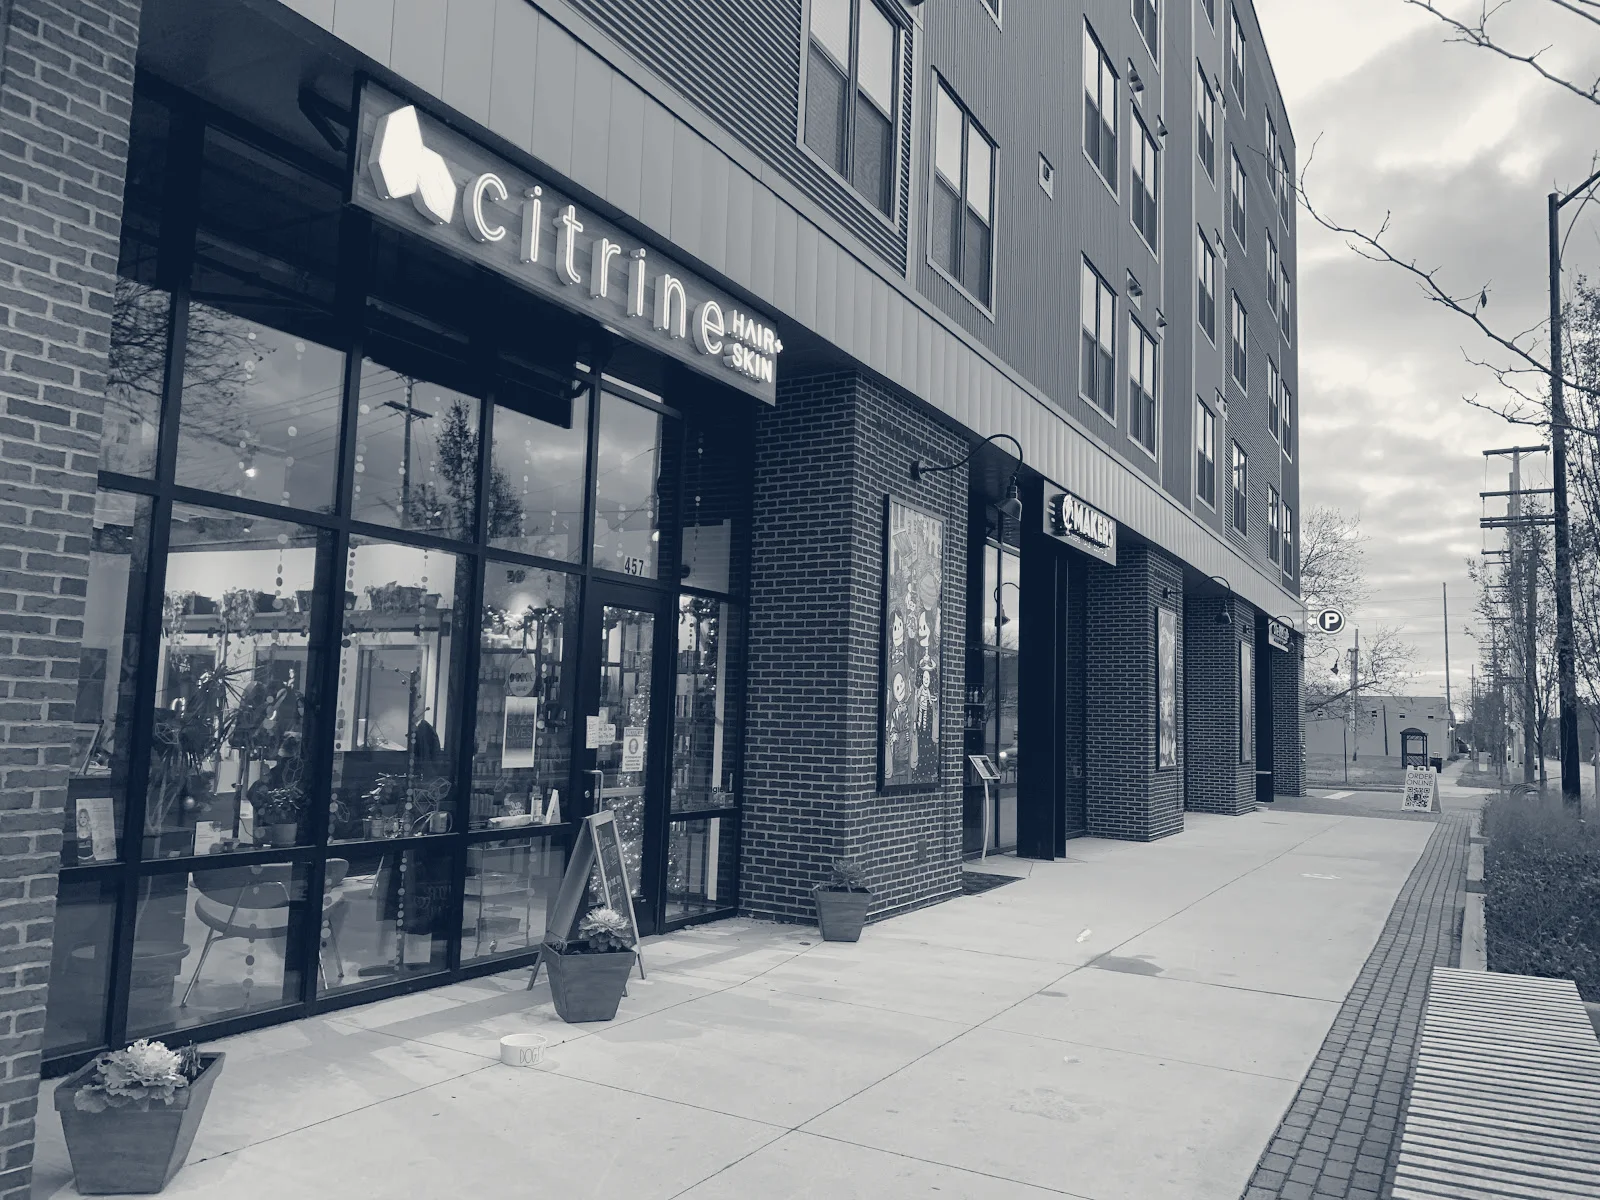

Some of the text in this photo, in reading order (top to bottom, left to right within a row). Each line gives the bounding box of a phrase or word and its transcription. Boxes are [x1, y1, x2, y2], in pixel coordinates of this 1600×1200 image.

[466, 172, 725, 354] citrine
[732, 342, 773, 384] SKIN
[1073, 500, 1114, 548] MAKERS
[624, 556, 644, 575] 457
[1324, 612, 1340, 629] P
[506, 727, 533, 738] LIVES
[1407, 772, 1433, 780] ORDER
